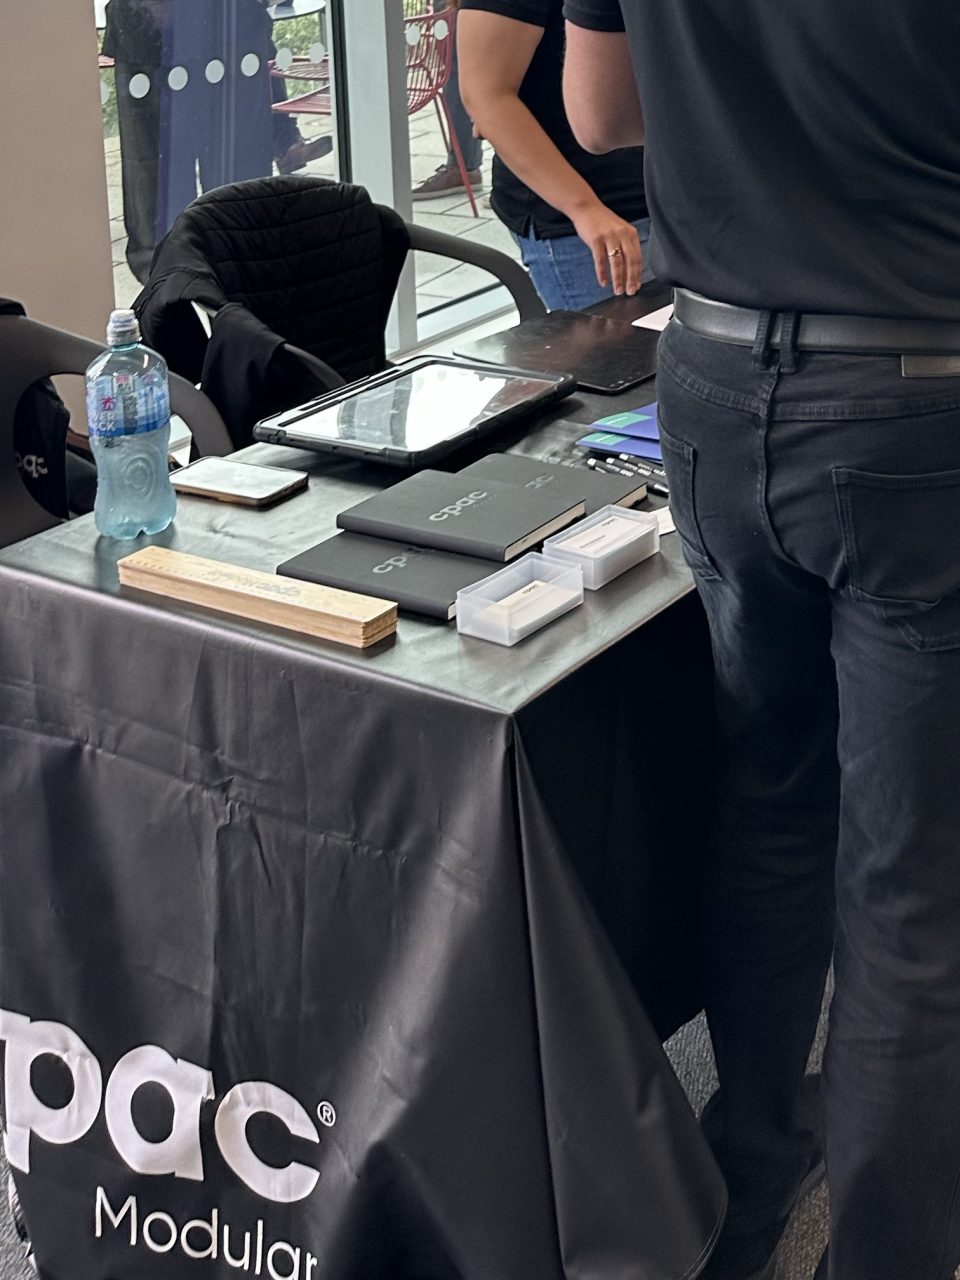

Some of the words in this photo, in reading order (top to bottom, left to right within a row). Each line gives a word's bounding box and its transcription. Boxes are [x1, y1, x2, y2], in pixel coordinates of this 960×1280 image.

[428, 490, 488, 521] cpac
[372, 552, 410, 574] cp
[95, 1185, 318, 1280] Modular
